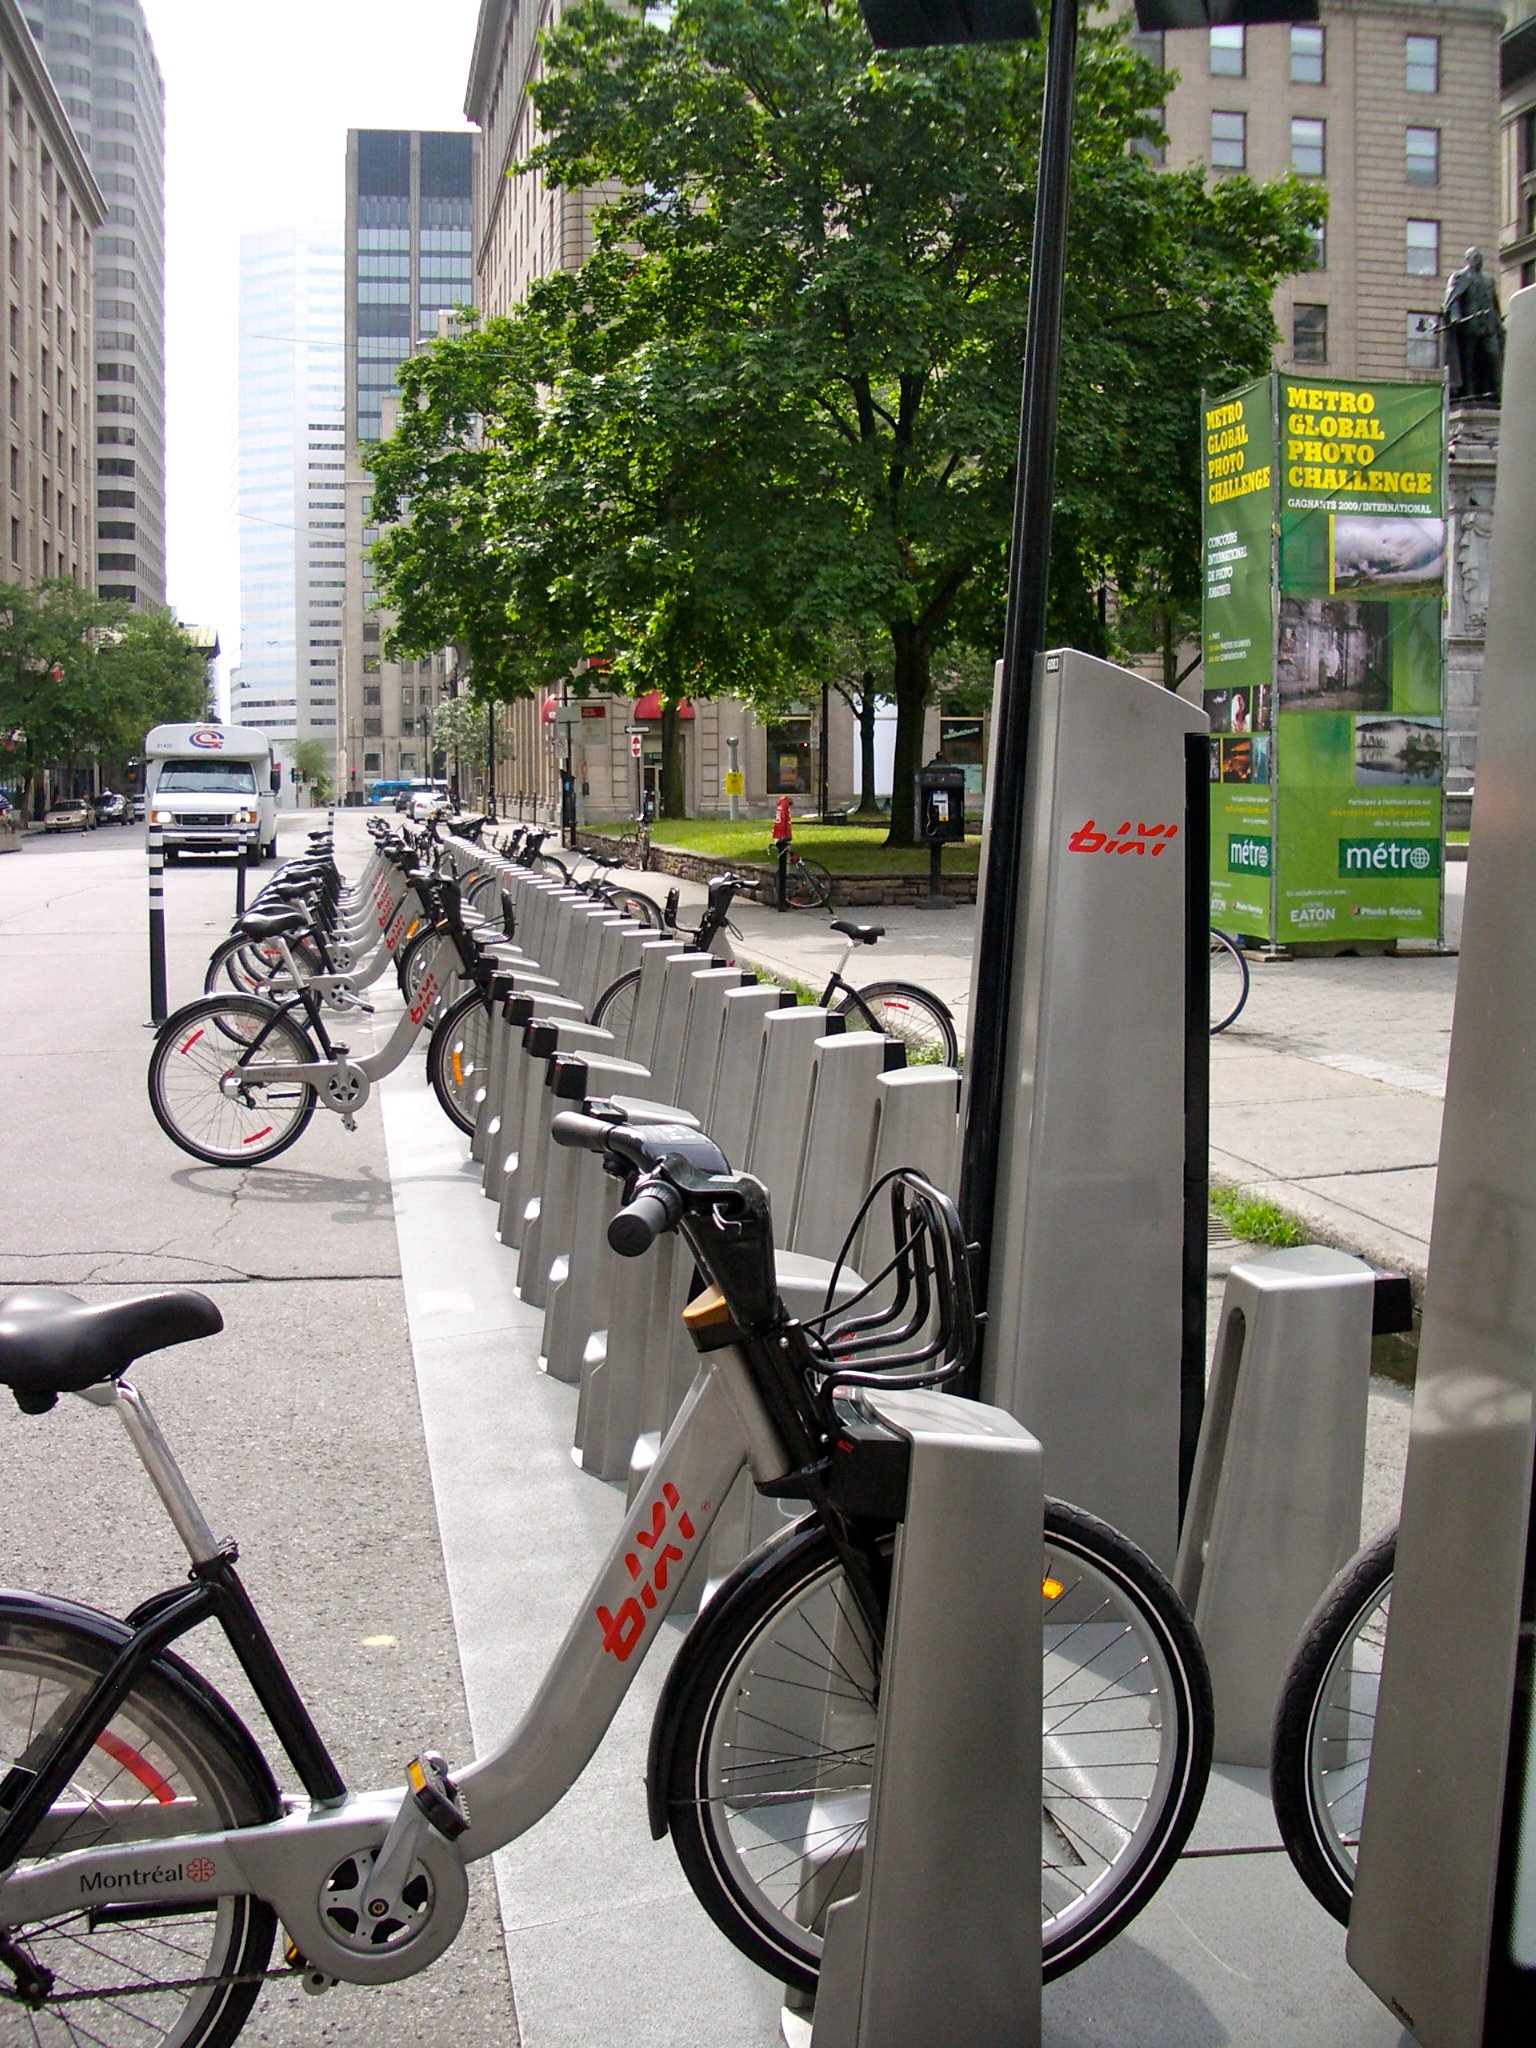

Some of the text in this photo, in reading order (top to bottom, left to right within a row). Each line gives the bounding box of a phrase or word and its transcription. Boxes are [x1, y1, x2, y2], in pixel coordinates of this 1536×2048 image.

[1287, 387, 1376, 414] METRO
[1205, 400, 1244, 431] METRO
[1288, 413, 1385, 440] GLOBAL
[1207, 424, 1249, 456] GLOBAL
[1287, 439, 1375, 466] PHOTO
[1207, 450, 1245, 480] PHOTO
[1208, 466, 1271, 504] CHALLENGE
[1288, 466, 1432, 494] CHALLENGE
[1287, 498, 1337, 510] GAGNANTS
[1068, 819, 1179, 856] bixi
[1231, 840, 1268, 868] métro
[1346, 842, 1430, 869] métro
[1290, 908, 1336, 922] EATON
[1361, 907, 1421, 917] Photo Service
[409, 973, 438, 1025] bixi
[594, 1482, 695, 1663] bixi
[80, 1863, 183, 1893] Montréal
